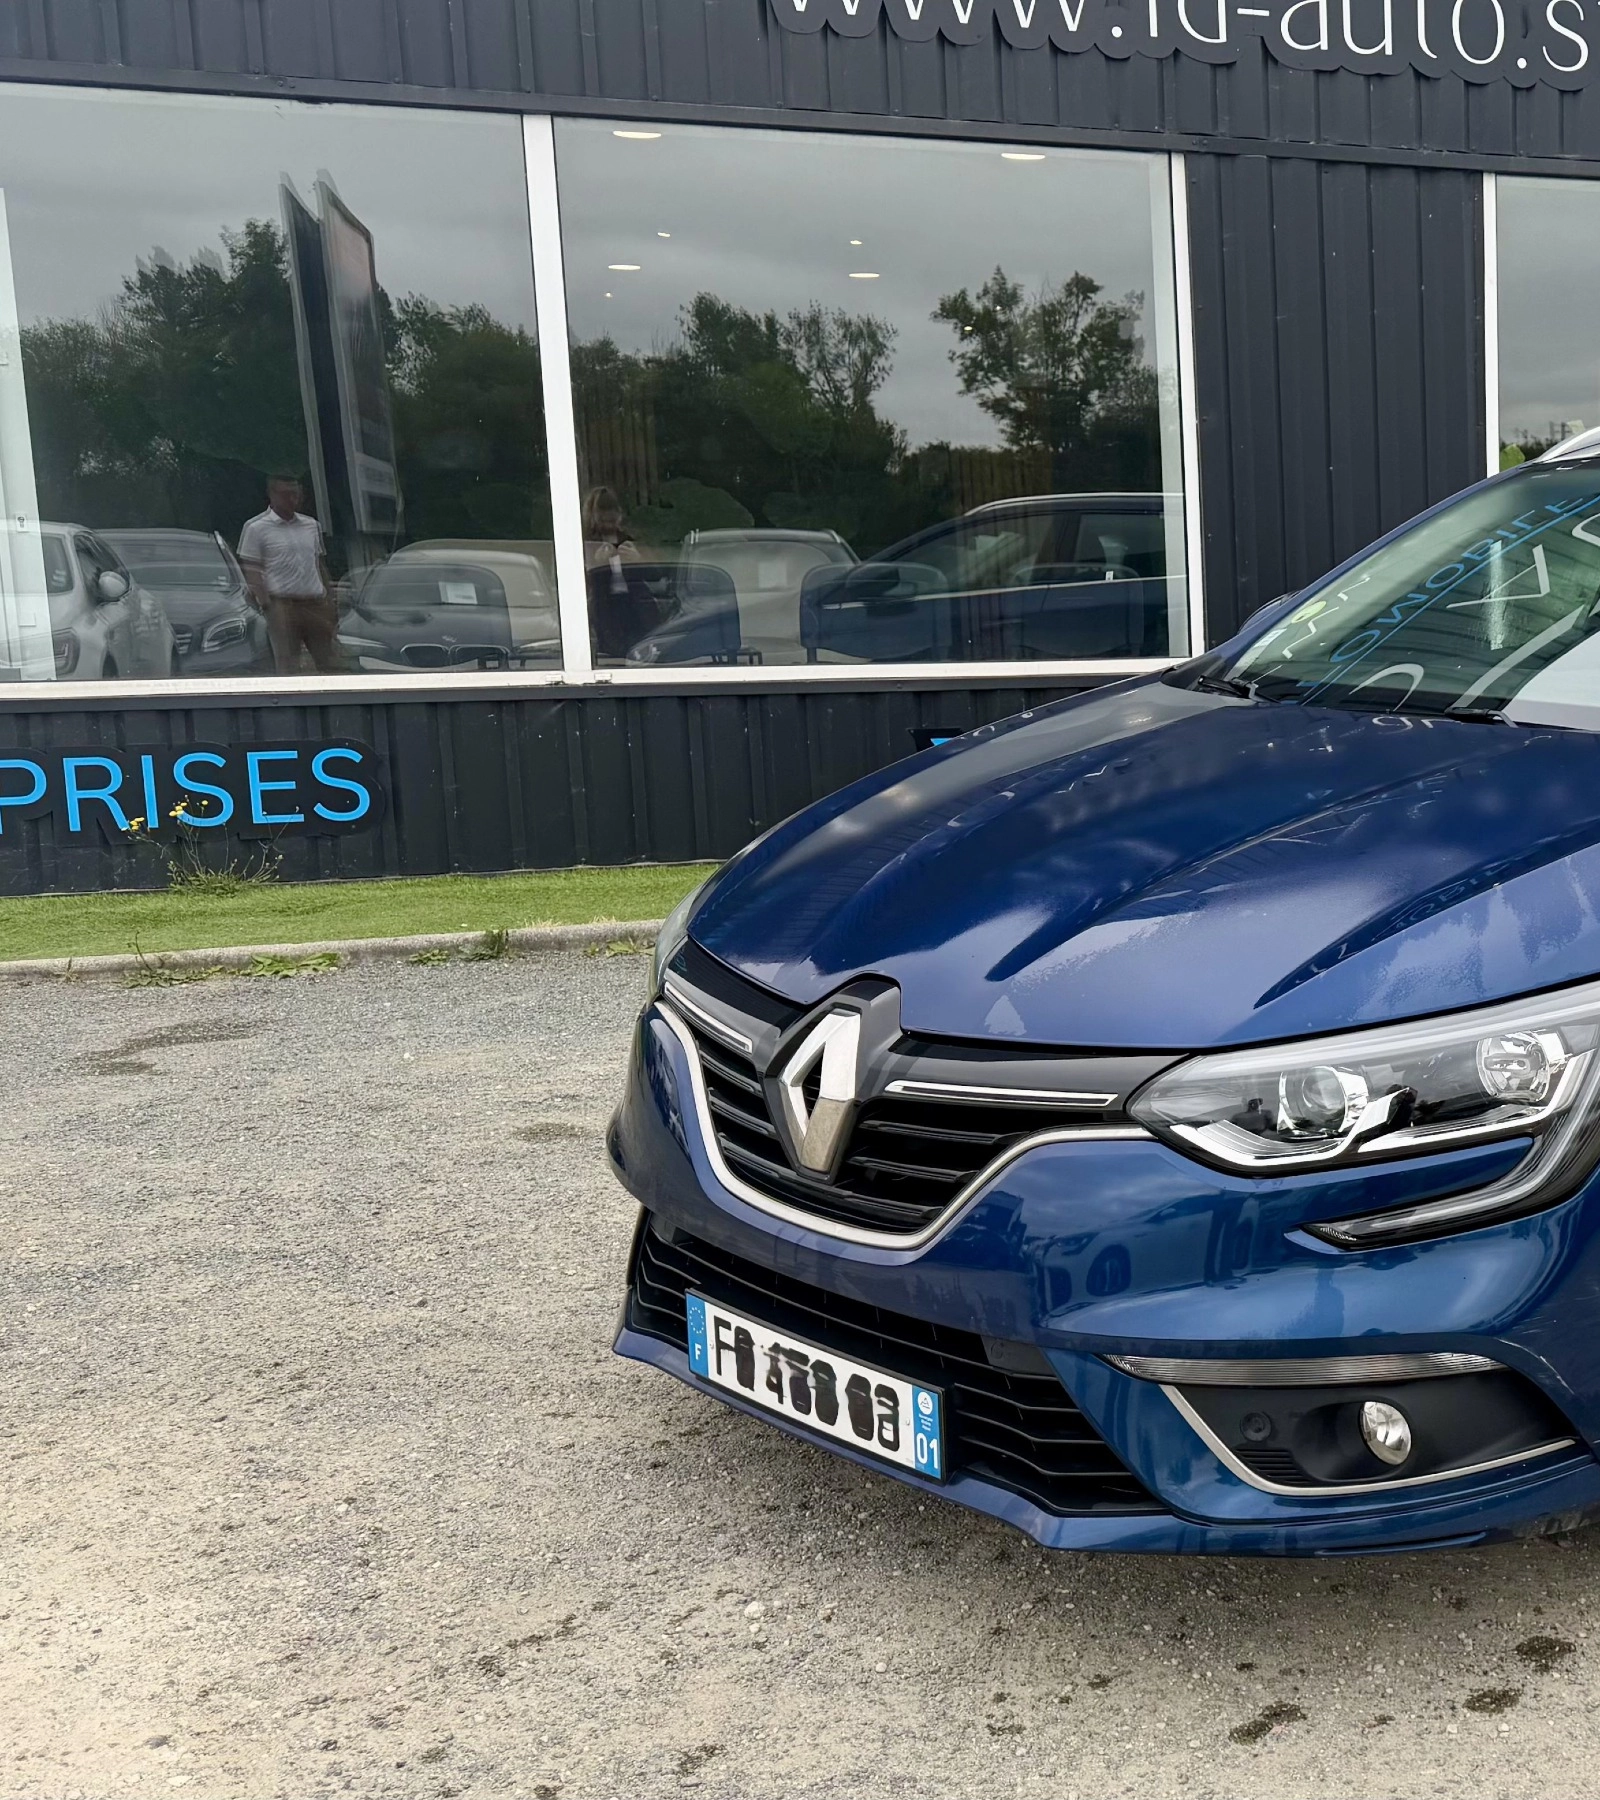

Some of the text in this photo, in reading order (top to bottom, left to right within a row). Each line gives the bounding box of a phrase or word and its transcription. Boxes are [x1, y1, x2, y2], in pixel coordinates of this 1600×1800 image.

[0, 748, 371, 834] PRISES
[694, 1342, 702, 1361] F
[916, 1432, 939, 1470] 01
